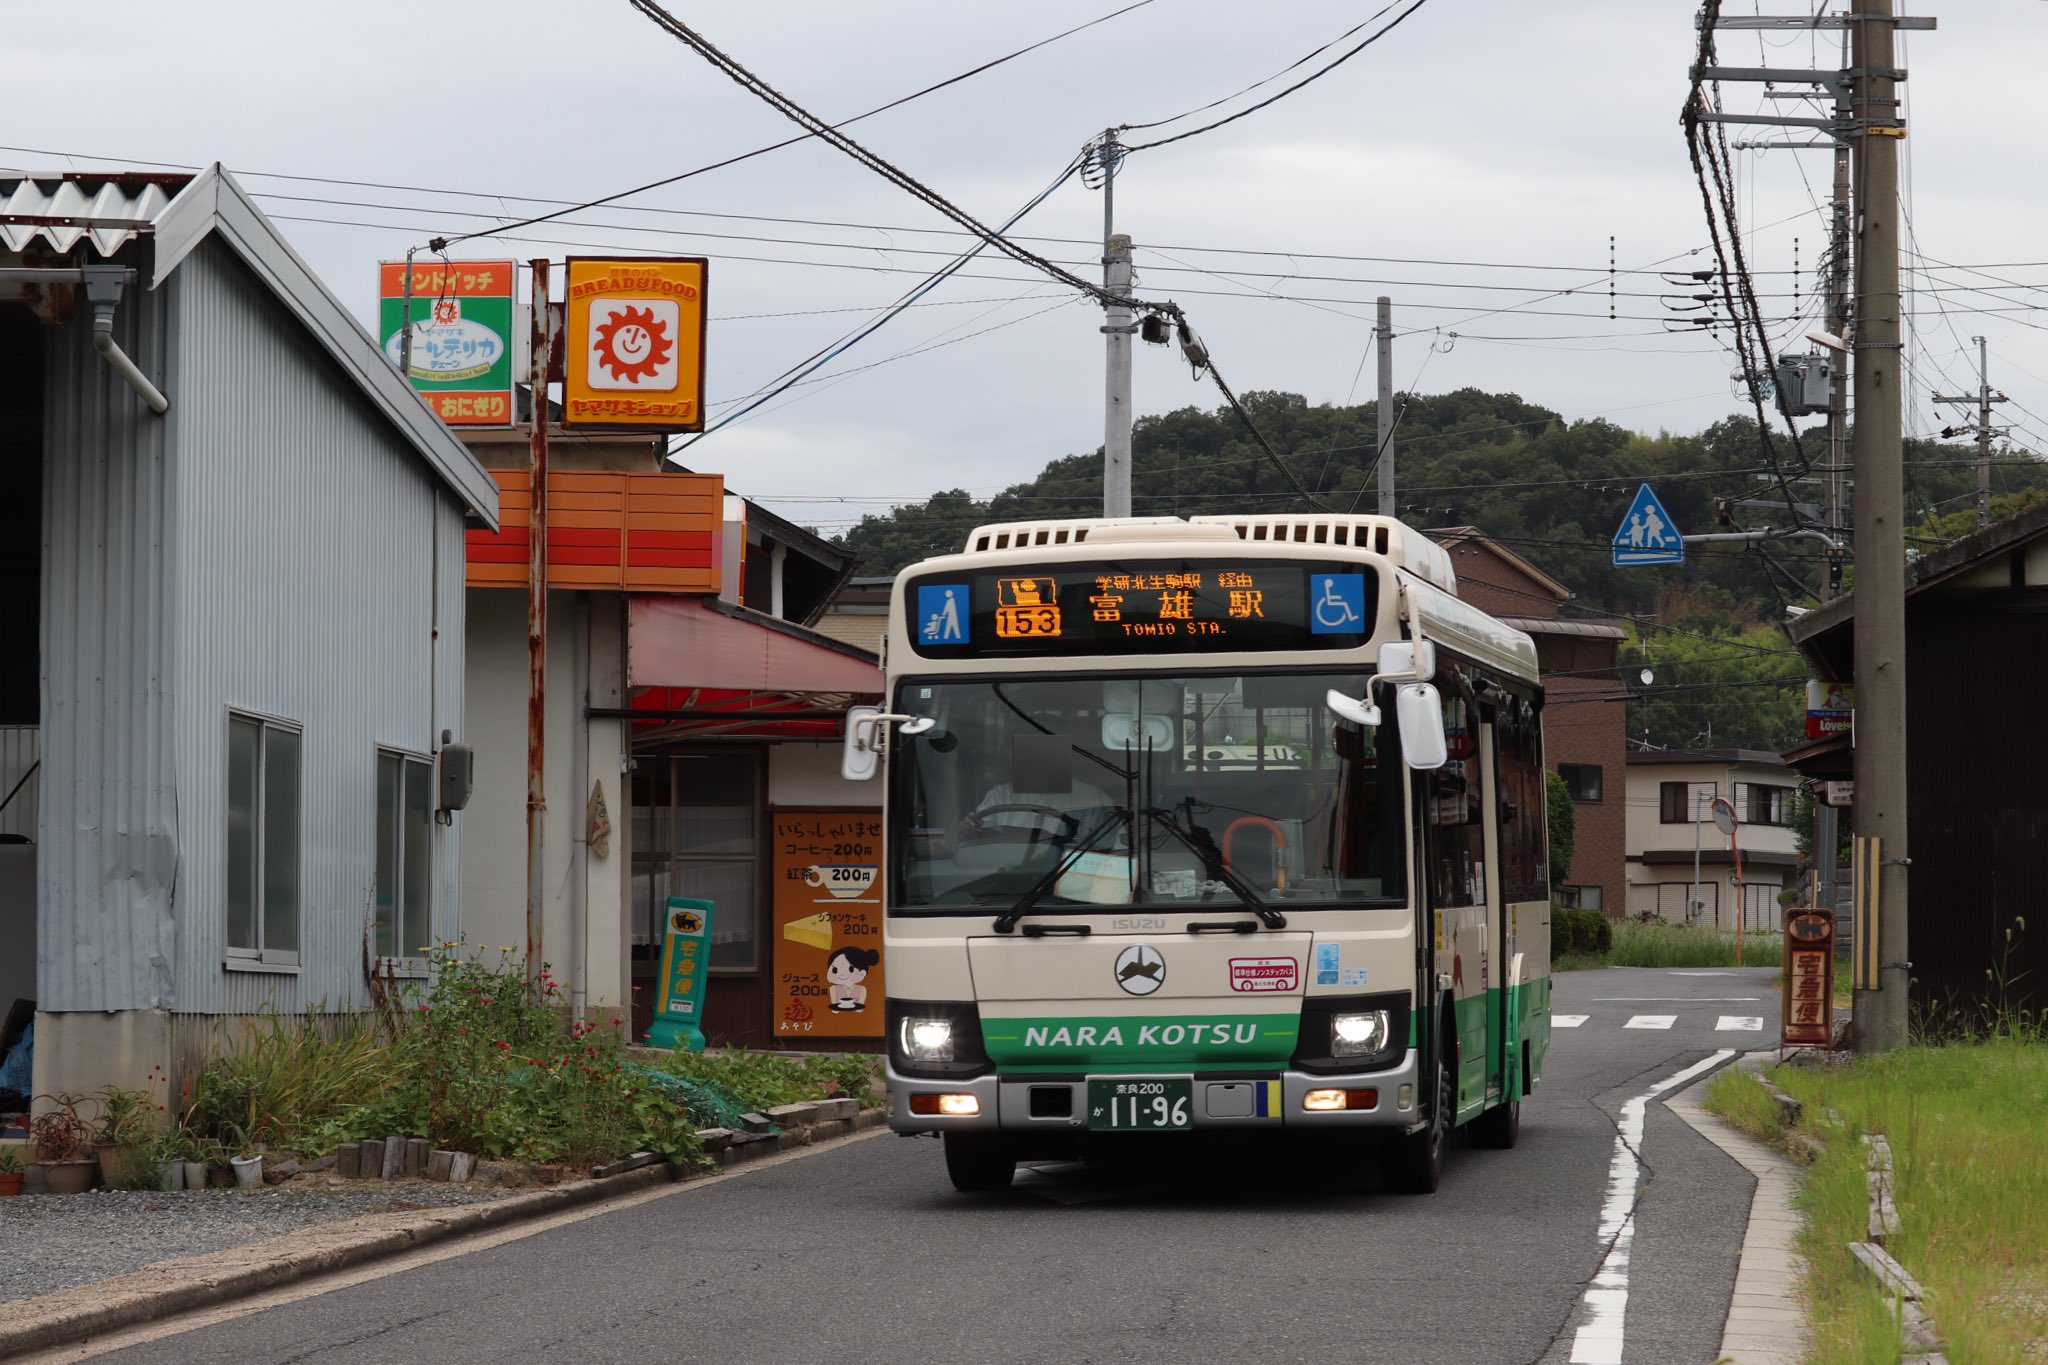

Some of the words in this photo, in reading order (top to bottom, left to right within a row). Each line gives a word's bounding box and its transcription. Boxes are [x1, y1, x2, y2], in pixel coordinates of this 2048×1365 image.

[572, 278, 697, 299] BREAD&FOOD
[431, 361, 460, 369] チェーン
[441, 397, 505, 417] おにぎり
[571, 399, 693, 417] ヤマザキショップ
[1095, 573, 1201, 591] 学研北生駒駅
[1218, 572, 1253, 588] 経由
[999, 608, 1056, 635] 153
[1122, 622, 1176, 636] TOMIO
[1187, 621, 1227, 635] STA.
[778, 821, 881, 838] いらっしゃいませ
[787, 868, 812, 880] 紅茶
[832, 868, 870, 881] 200円
[818, 912, 867, 923] シフォンケーキ
[1112, 919, 1165, 930] ISUZU
[674, 939, 698, 995] 宅急便
[783, 973, 819, 983] ジュース
[790, 985, 828, 996] 200円
[1796, 953, 1821, 1023] 宅急便
[780, 1022, 813, 1031] あそび
[1025, 1026, 1124, 1047] NARA
[1137, 1024, 1257, 1045] KOTSU
[1093, 1107, 1104, 1117] か
[1111, 1096, 1188, 1127] 11-96
